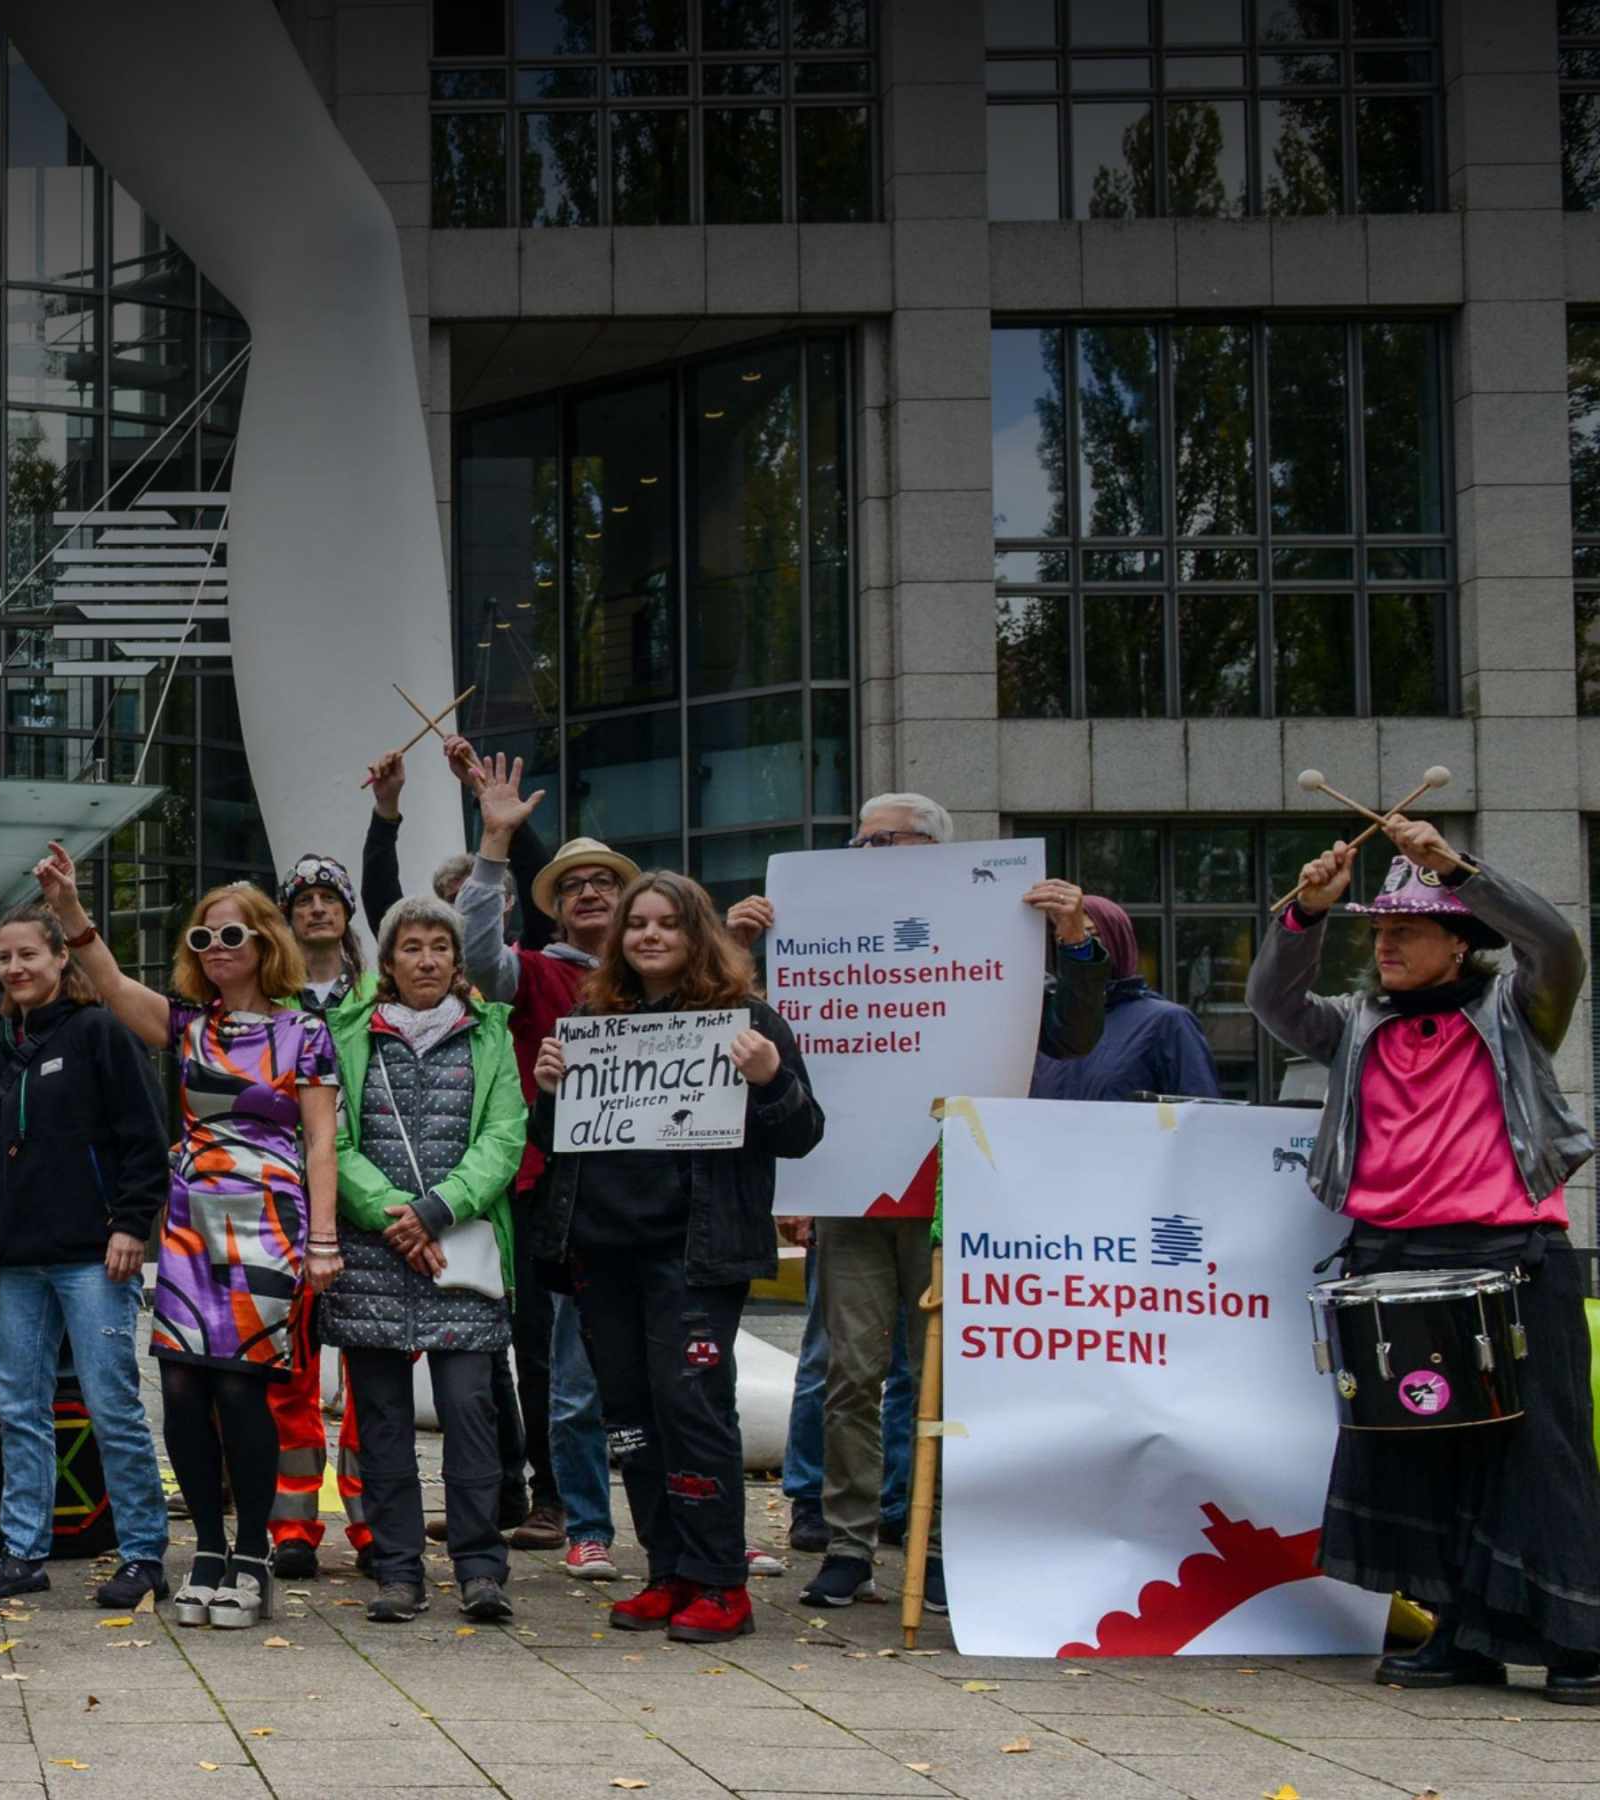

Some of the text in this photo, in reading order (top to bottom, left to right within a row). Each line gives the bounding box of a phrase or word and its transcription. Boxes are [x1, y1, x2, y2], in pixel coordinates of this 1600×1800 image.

[776, 936, 851, 956] Munich
[857, 935, 885, 953] RE
[777, 959, 1004, 988] Entschlossenheit
[777, 998, 947, 1022] für die neuen
[558, 1020, 600, 1043] Munich
[668, 1015, 687, 1031] ihr
[795, 1031, 921, 1055] limaziele!
[590, 1044, 618, 1055] mehr
[600, 1090, 706, 1112] verlieren wir
[570, 1111, 635, 1146] alle
[960, 1232, 1083, 1262] Munich
[1093, 1236, 1138, 1264] RE
[960, 1273, 1271, 1319] LNG-Expansion
[960, 1325, 1168, 1366] STOPPEN!
